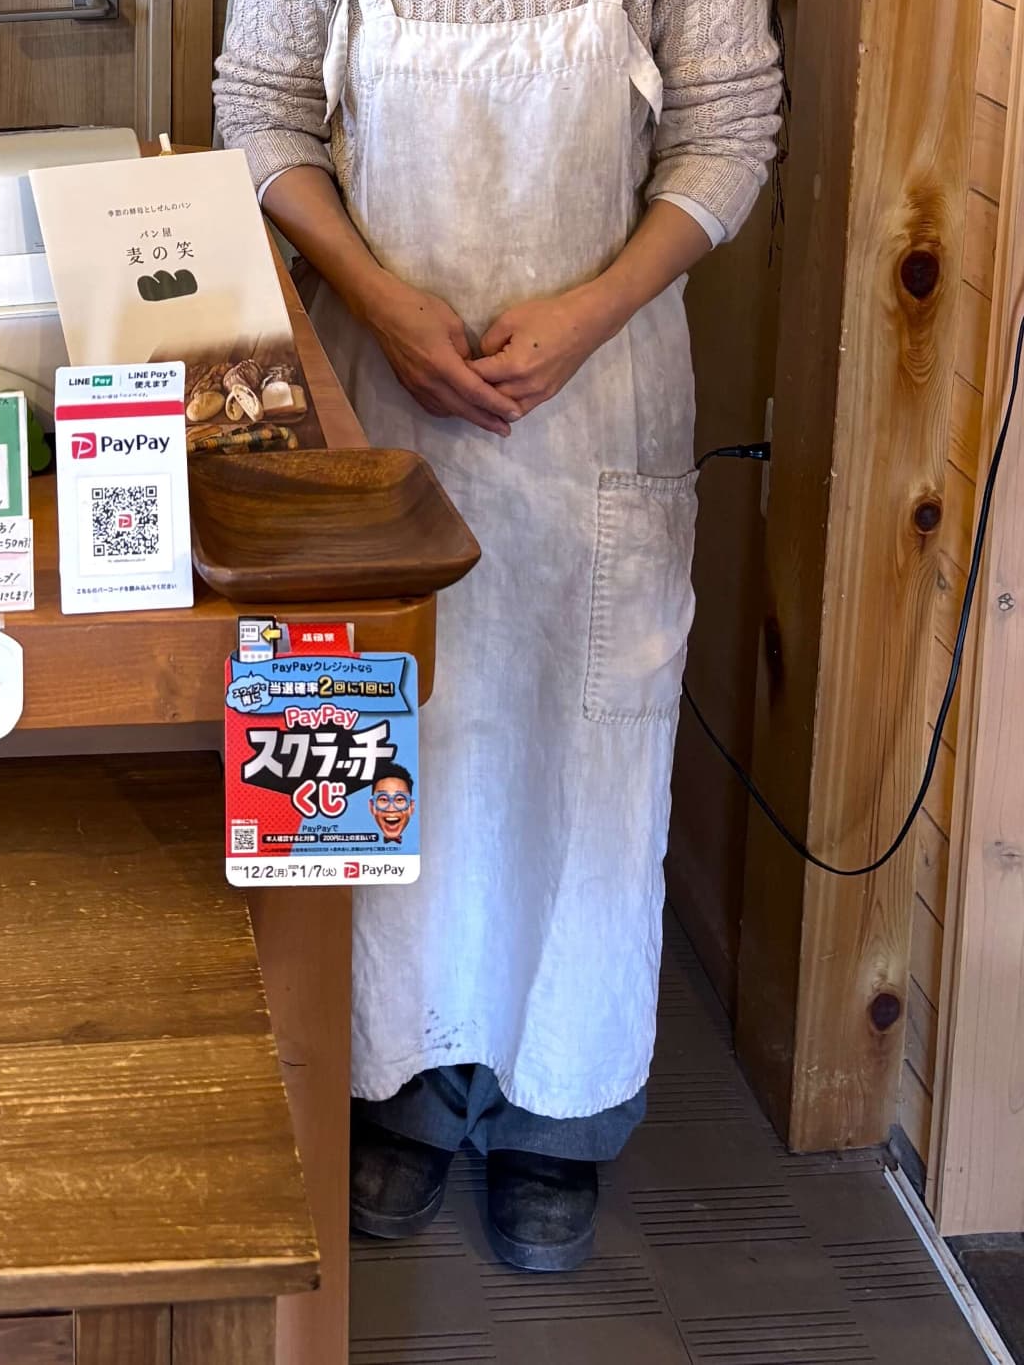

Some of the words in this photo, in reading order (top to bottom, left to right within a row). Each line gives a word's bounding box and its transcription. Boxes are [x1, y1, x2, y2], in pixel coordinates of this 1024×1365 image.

[140, 227, 172, 239] パン屋
[126, 241, 194, 266] 麦の笑
[69, 378, 90, 386] LINE
[94, 376, 111, 385] Pay
[134, 380, 169, 389] 使えます
[101, 434, 170, 456] PayPay
[272, 662, 373, 674] PayPayクレジットなら
[286, 706, 357, 729] PayPay
[244, 721, 394, 781] スクラッチ
[293, 781, 347, 816] くじ
[302, 824, 339, 834] PayPayで
[362, 864, 405, 876] PayPay
